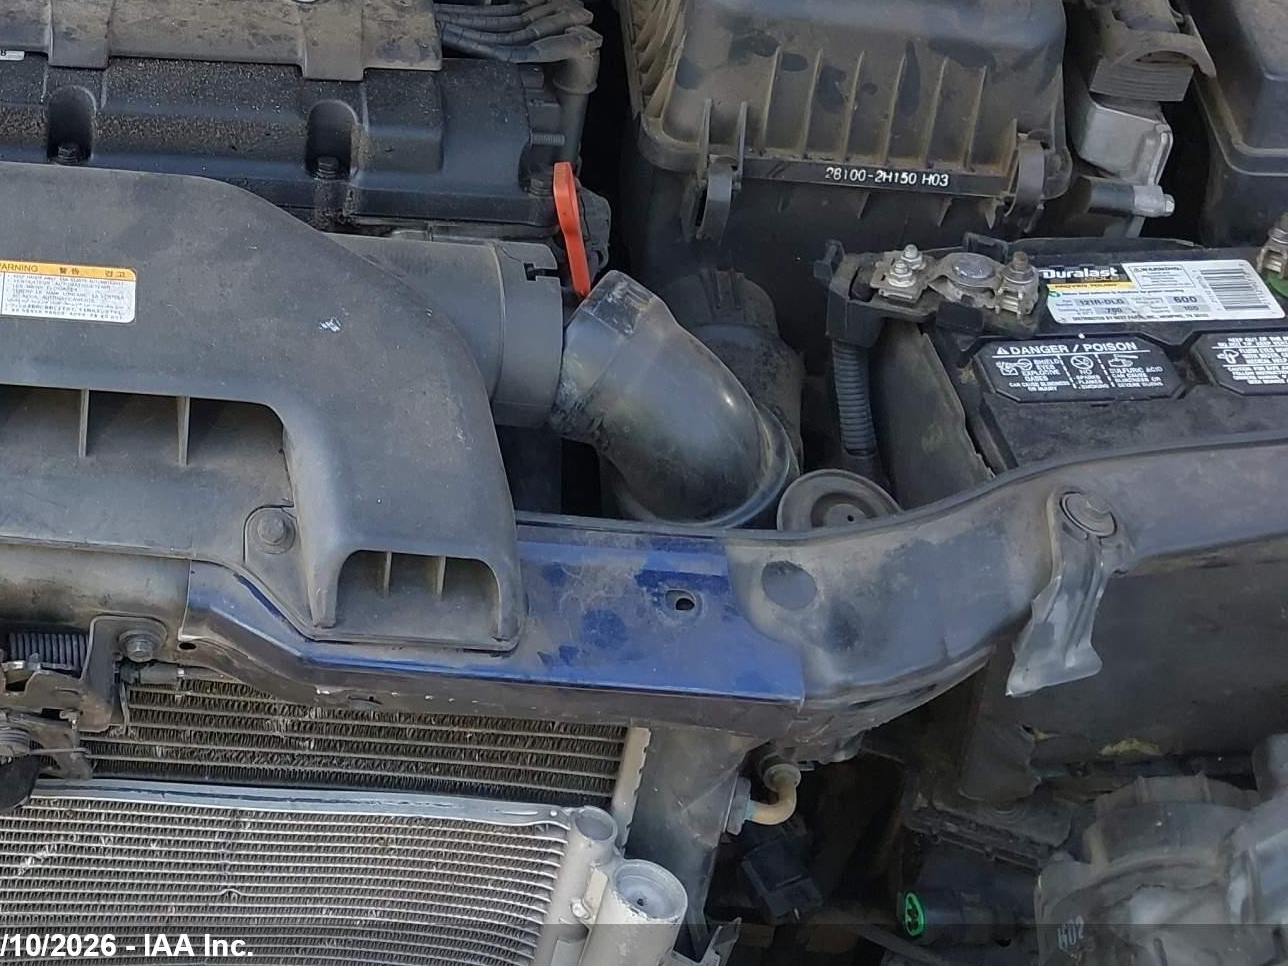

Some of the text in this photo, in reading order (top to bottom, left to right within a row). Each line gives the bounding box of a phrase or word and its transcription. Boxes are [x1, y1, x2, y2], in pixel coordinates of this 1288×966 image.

[824, 166, 949, 187] 28100-2H150 H03
[1038, 267, 1118, 279] Duralast
[1173, 295, 1198, 303] 600
[1009, 344, 1069, 354] DANGER
[1083, 342, 1138, 352] POISON
